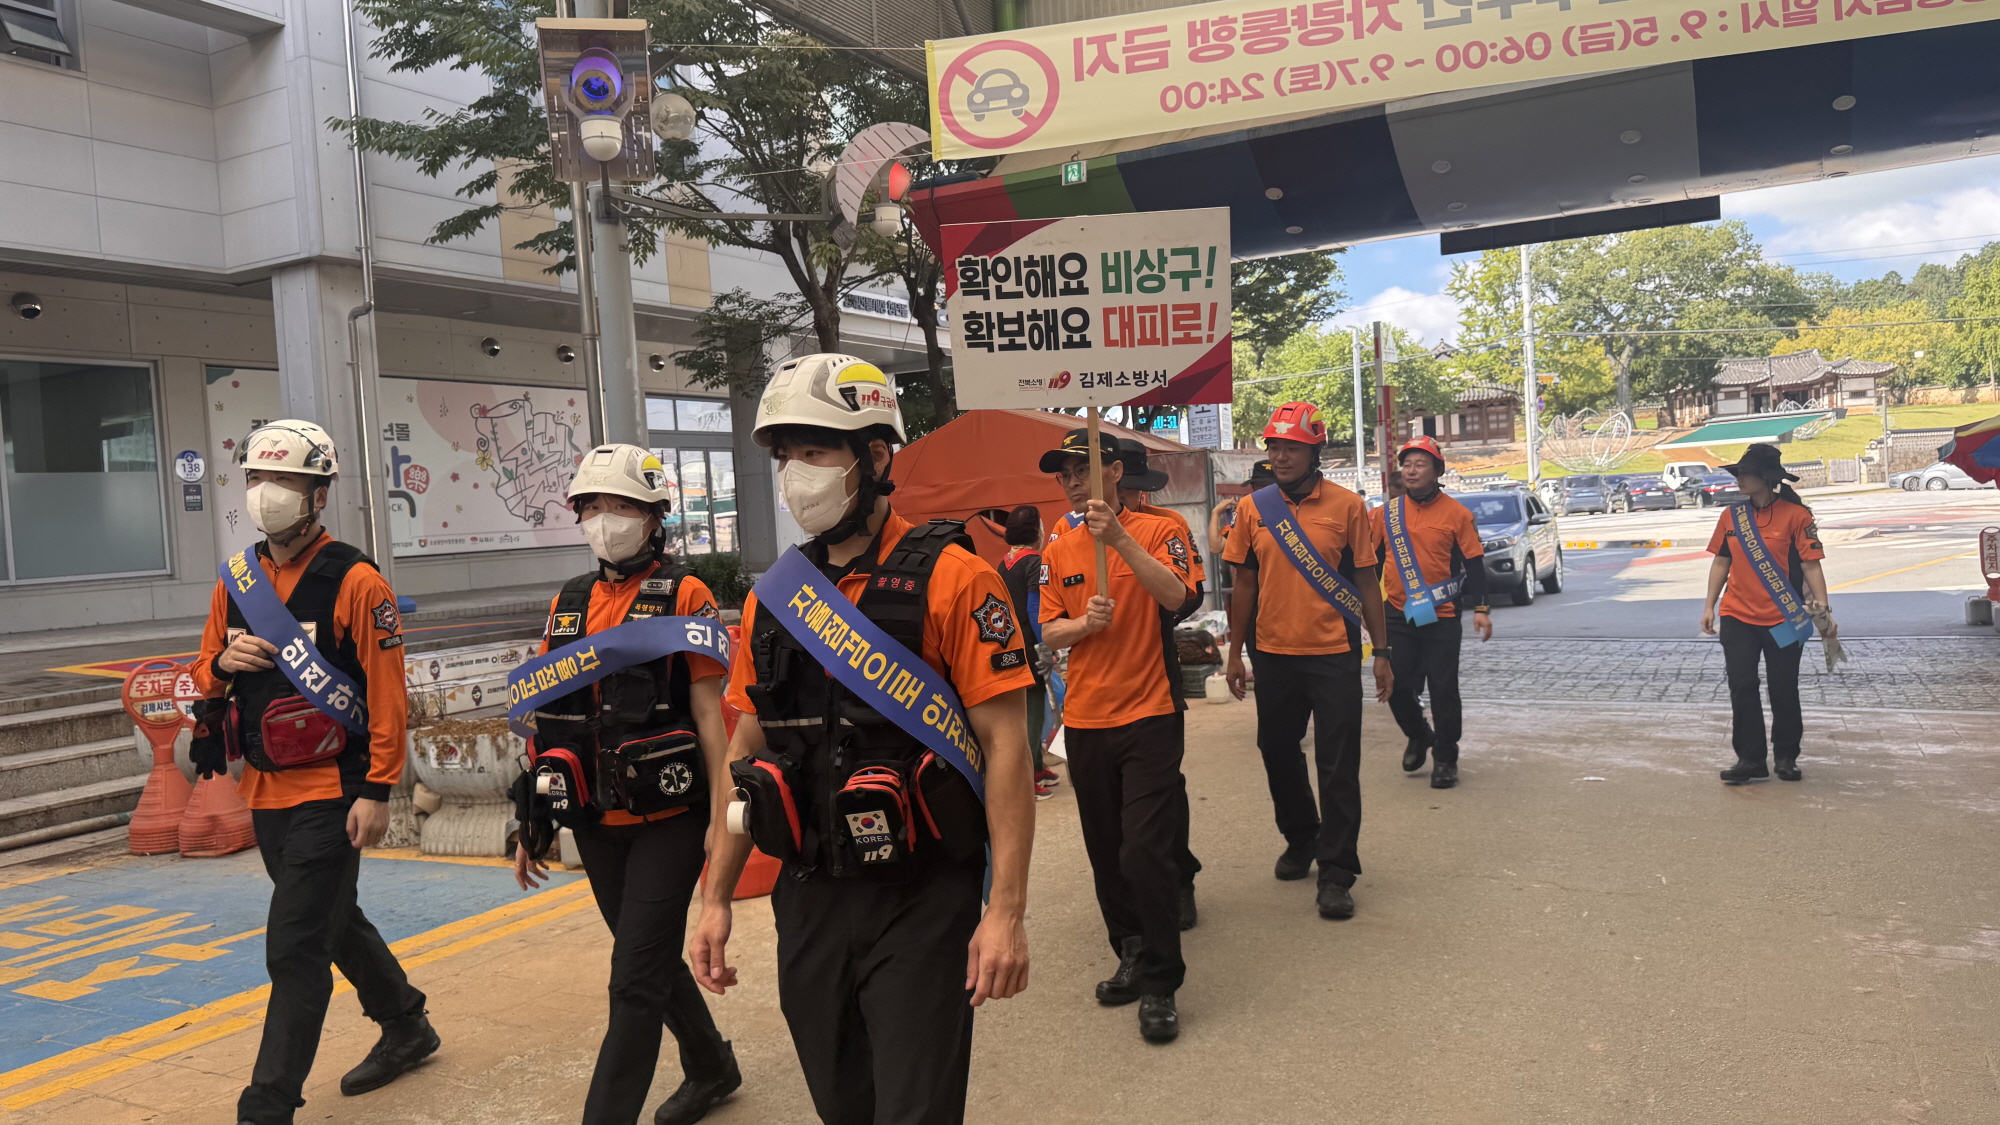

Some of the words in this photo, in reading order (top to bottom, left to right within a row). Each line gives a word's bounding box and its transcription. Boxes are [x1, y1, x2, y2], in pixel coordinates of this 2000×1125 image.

[957, 252, 1090, 301] 확인해요
[1100, 246, 1218, 295] 비상구!
[962, 306, 1092, 353] 확보해요
[1102, 302, 1218, 348] 대피로!
[1048, 371, 1071, 390] 119
[1079, 369, 1168, 389] 김제소방서
[861, 389, 880, 403] 119
[258, 450, 289, 460] 119
[181, 463, 201, 473] 138
[1275, 519, 1340, 593] 자율점검으로
[1986, 534, 1999, 571] 주차금지
[787, 583, 926, 710] 자율점검으로
[552, 799, 569, 809] 119
[855, 835, 891, 844] KOREA
[864, 844, 894, 862] 119
